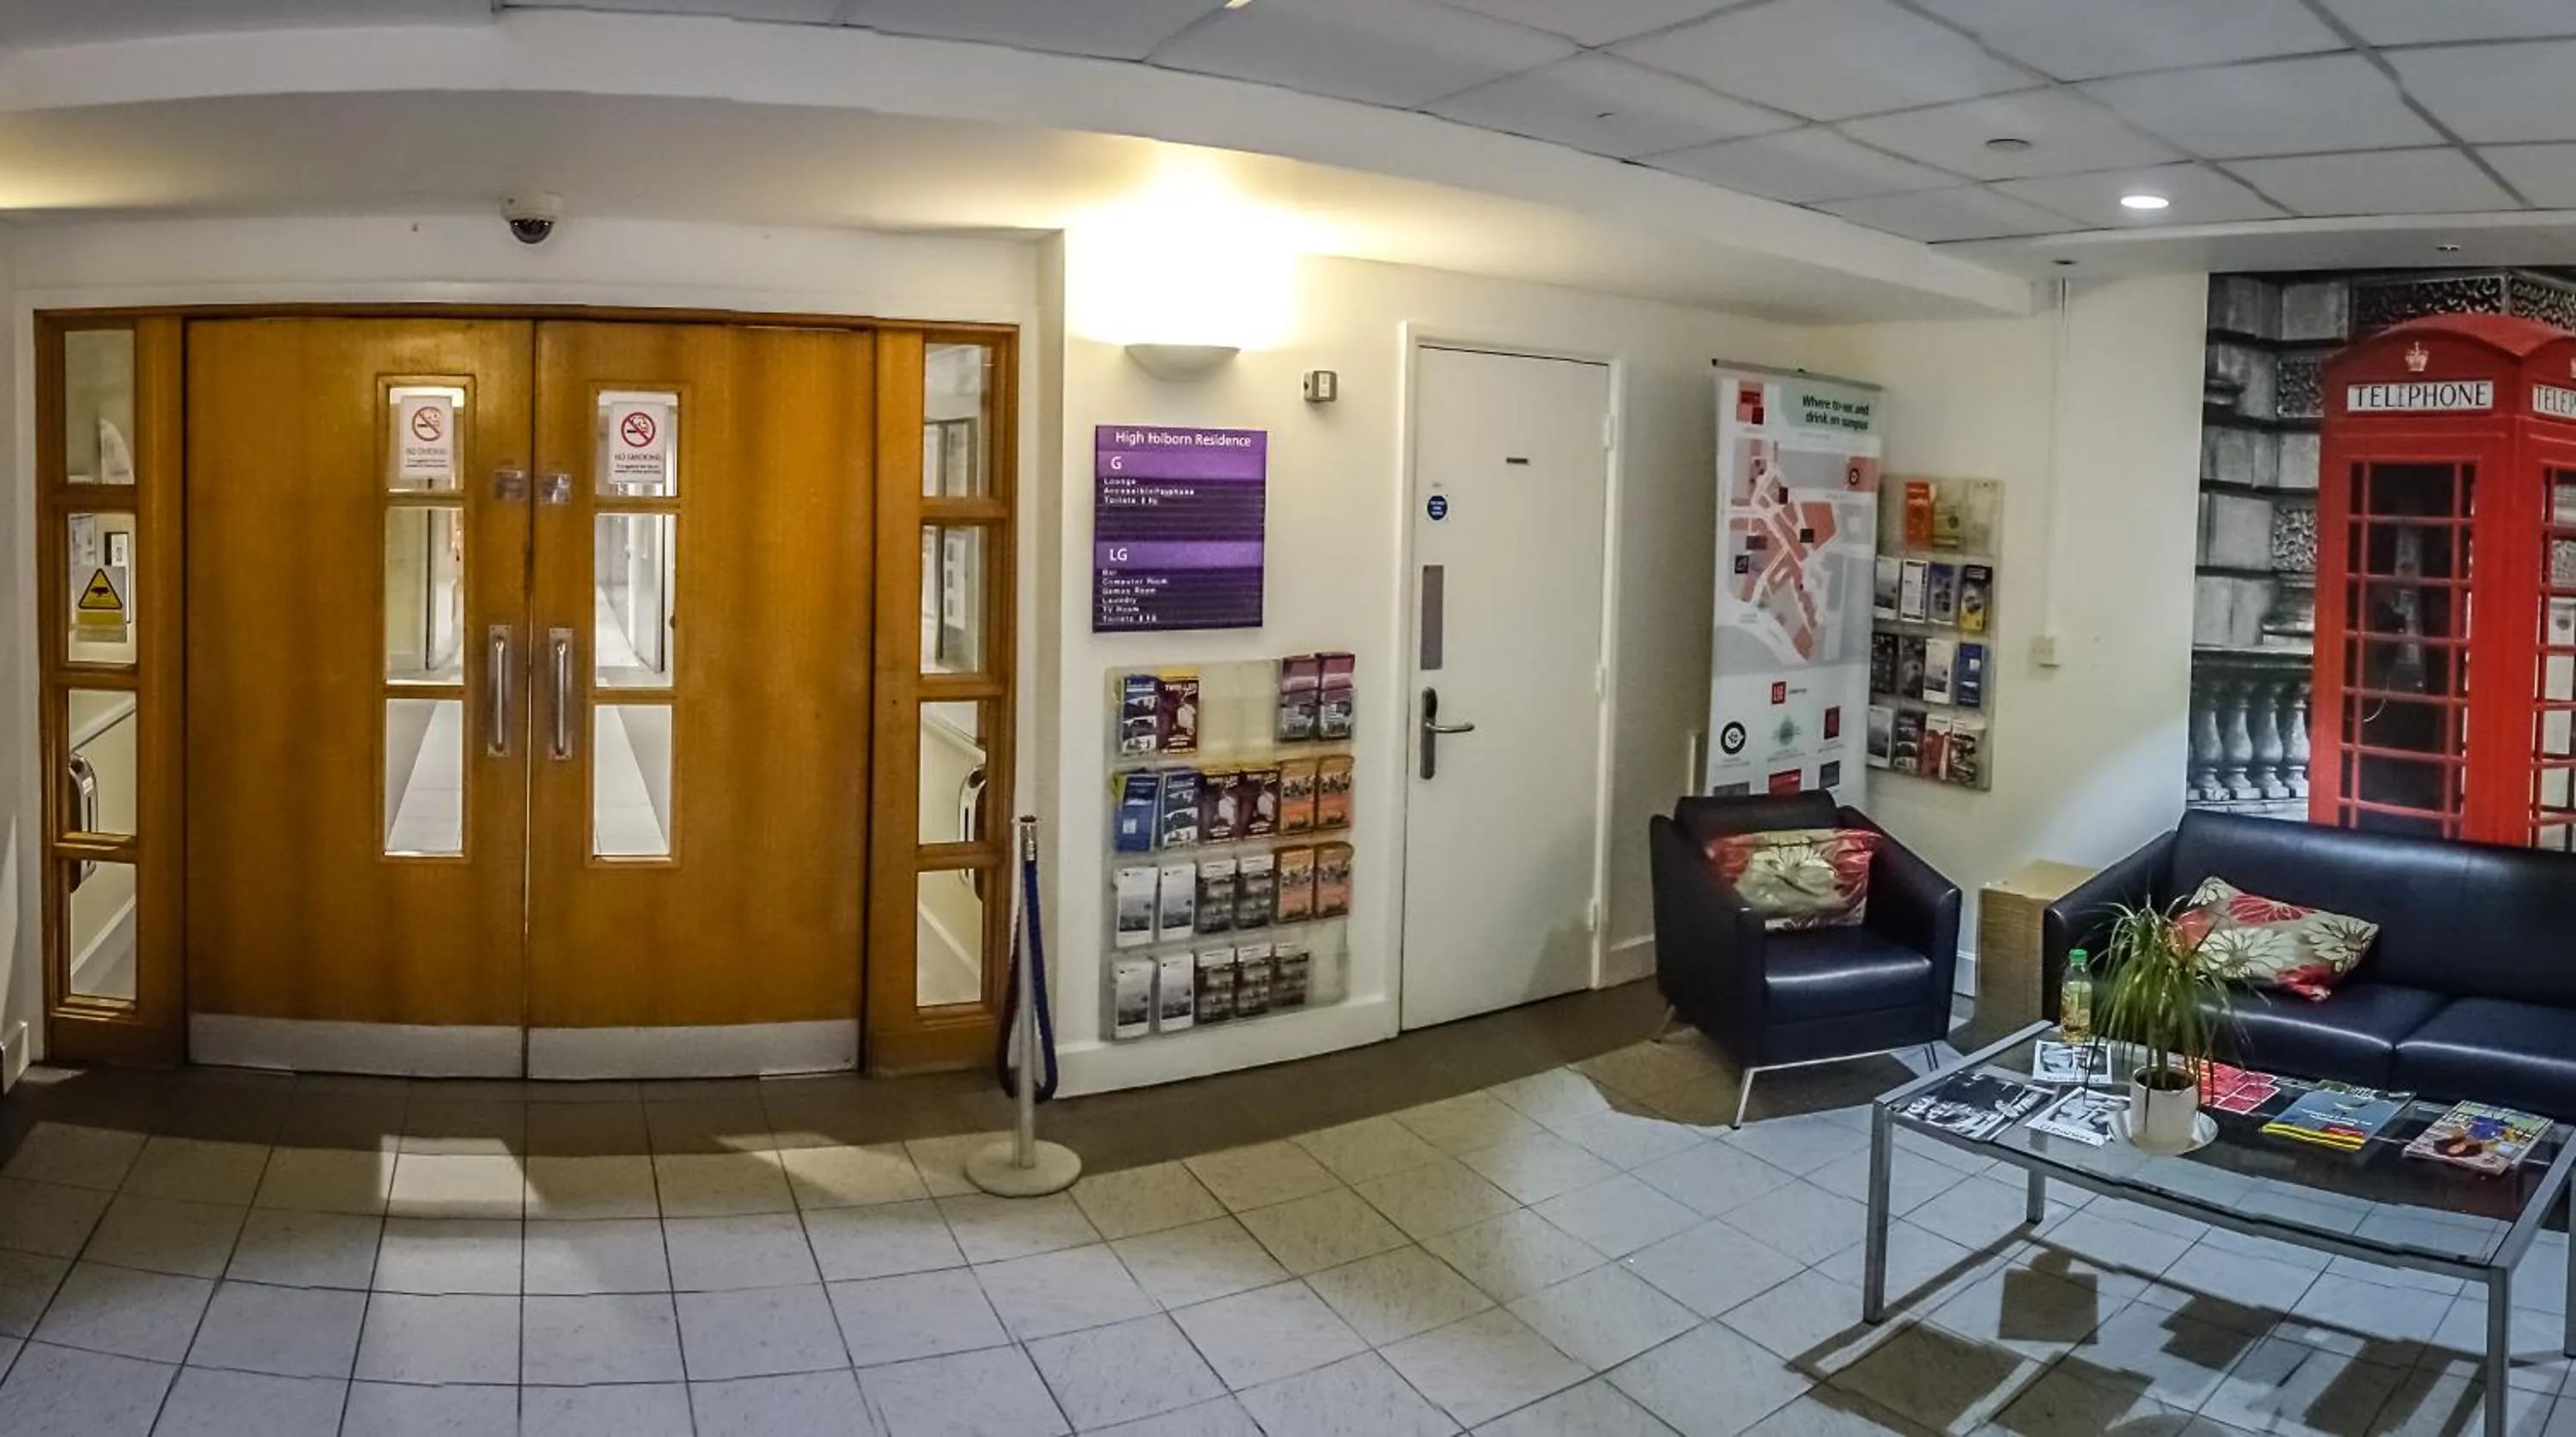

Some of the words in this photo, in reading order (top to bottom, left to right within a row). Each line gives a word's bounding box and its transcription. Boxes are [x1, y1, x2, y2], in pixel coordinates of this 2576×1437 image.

[1802, 394, 1832, 409] Where
[2355, 383, 2488, 408] TELEPHONE
[1806, 410, 1828, 424] drink
[1115, 431, 1145, 446] High
[1147, 432, 1193, 446] Holborn
[1194, 434, 1252, 447] Residence
[1110, 456, 1122, 470] G
[1109, 548, 1127, 561] LG
